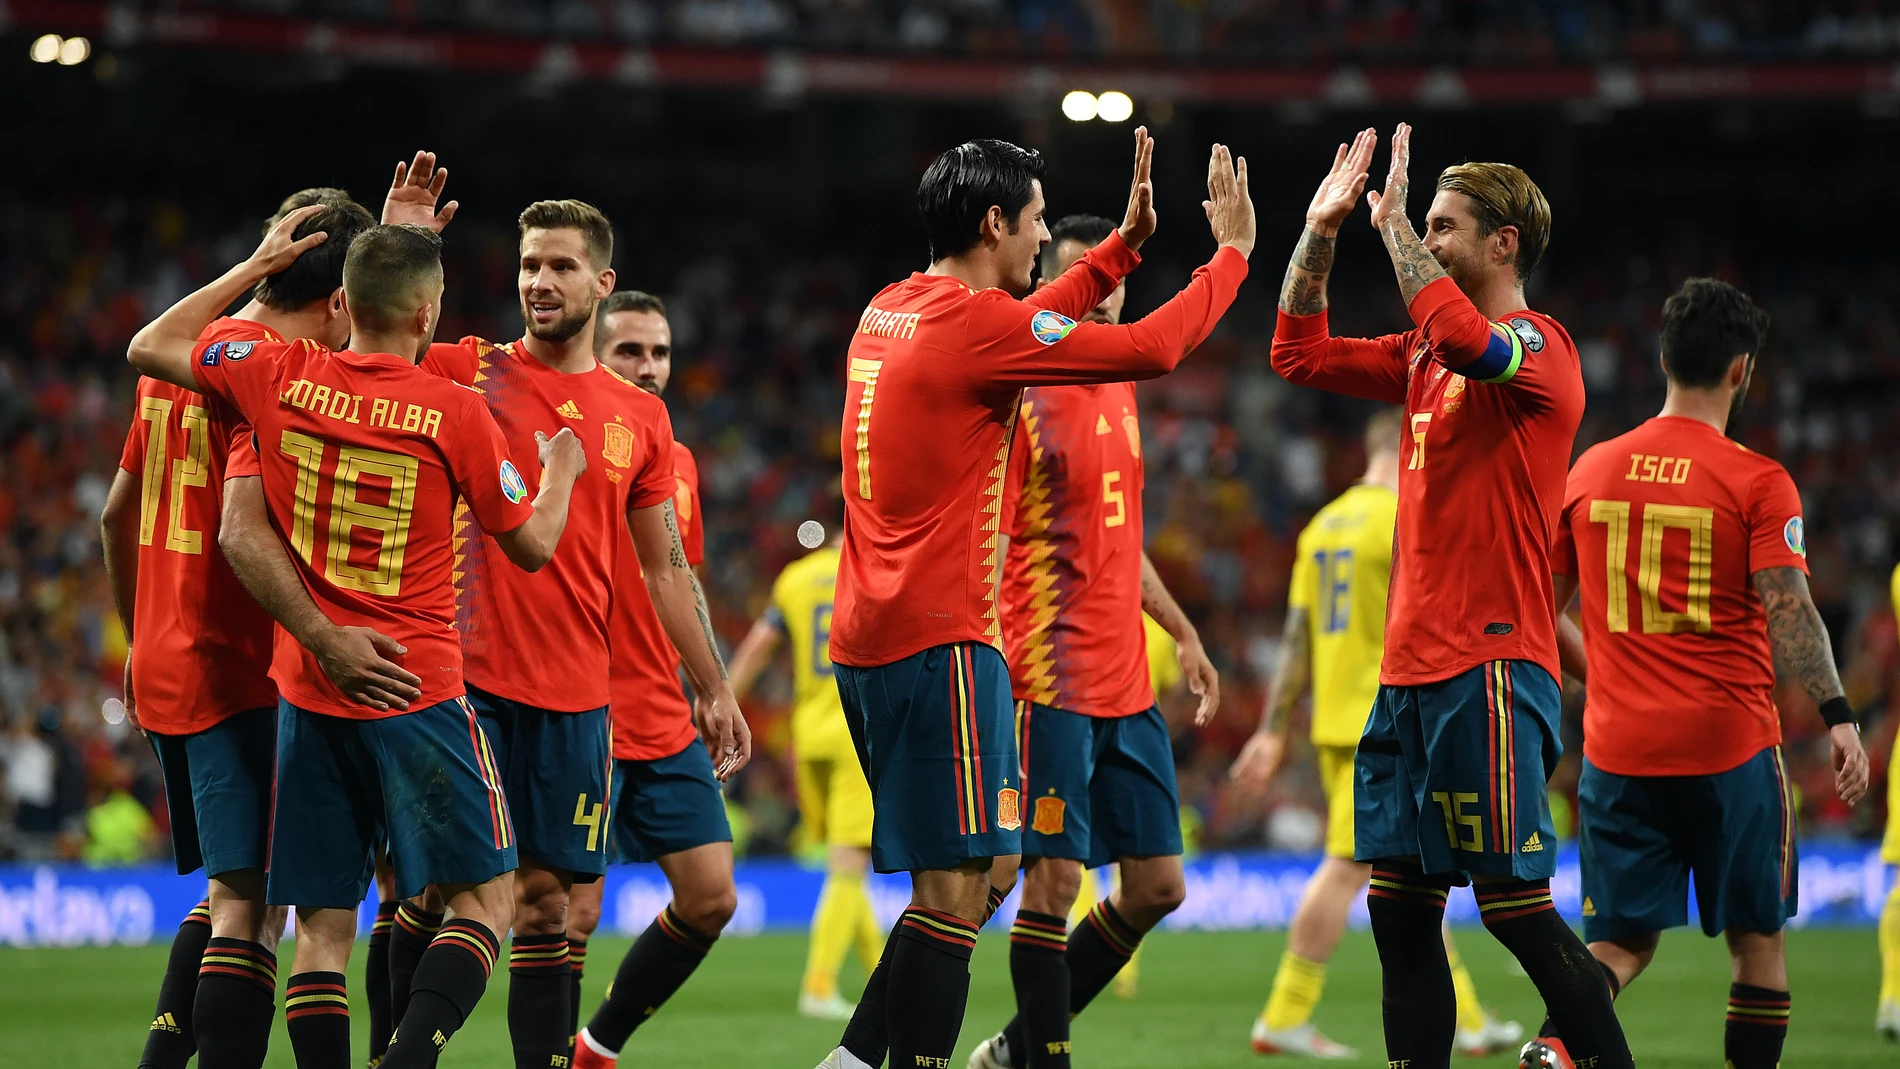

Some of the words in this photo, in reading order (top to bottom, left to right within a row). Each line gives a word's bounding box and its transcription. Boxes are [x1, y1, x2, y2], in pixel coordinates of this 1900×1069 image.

[279, 379, 364, 424] JORDI
[369, 397, 443, 439] ALBA
[849, 357, 883, 500] 7
[139, 396, 211, 555] 12
[1102, 470, 1126, 528] 5
[1625, 453, 1692, 485] ISCO
[280, 429, 420, 597] 18
[1313, 550, 1354, 633] 18
[1589, 499, 1714, 635] 10
[573, 793, 602, 851] 4
[1432, 791, 1484, 852] 15
